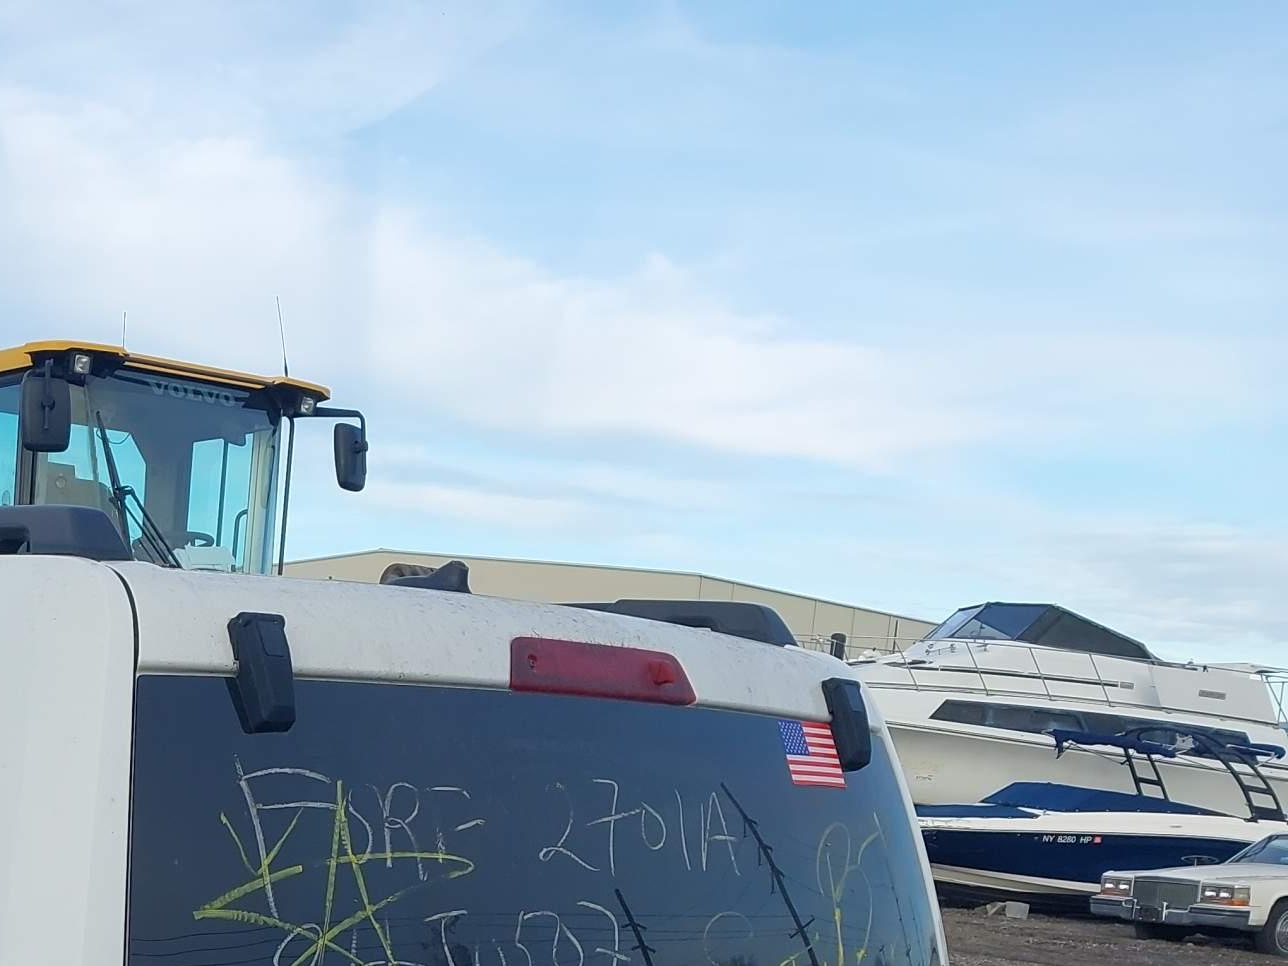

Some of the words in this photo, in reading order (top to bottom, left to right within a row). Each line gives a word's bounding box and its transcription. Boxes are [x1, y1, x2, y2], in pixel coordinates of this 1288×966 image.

[150, 380, 236, 408] VOLVO
[1042, 834, 1056, 843] NY
[1079, 836, 1093, 844] HP
